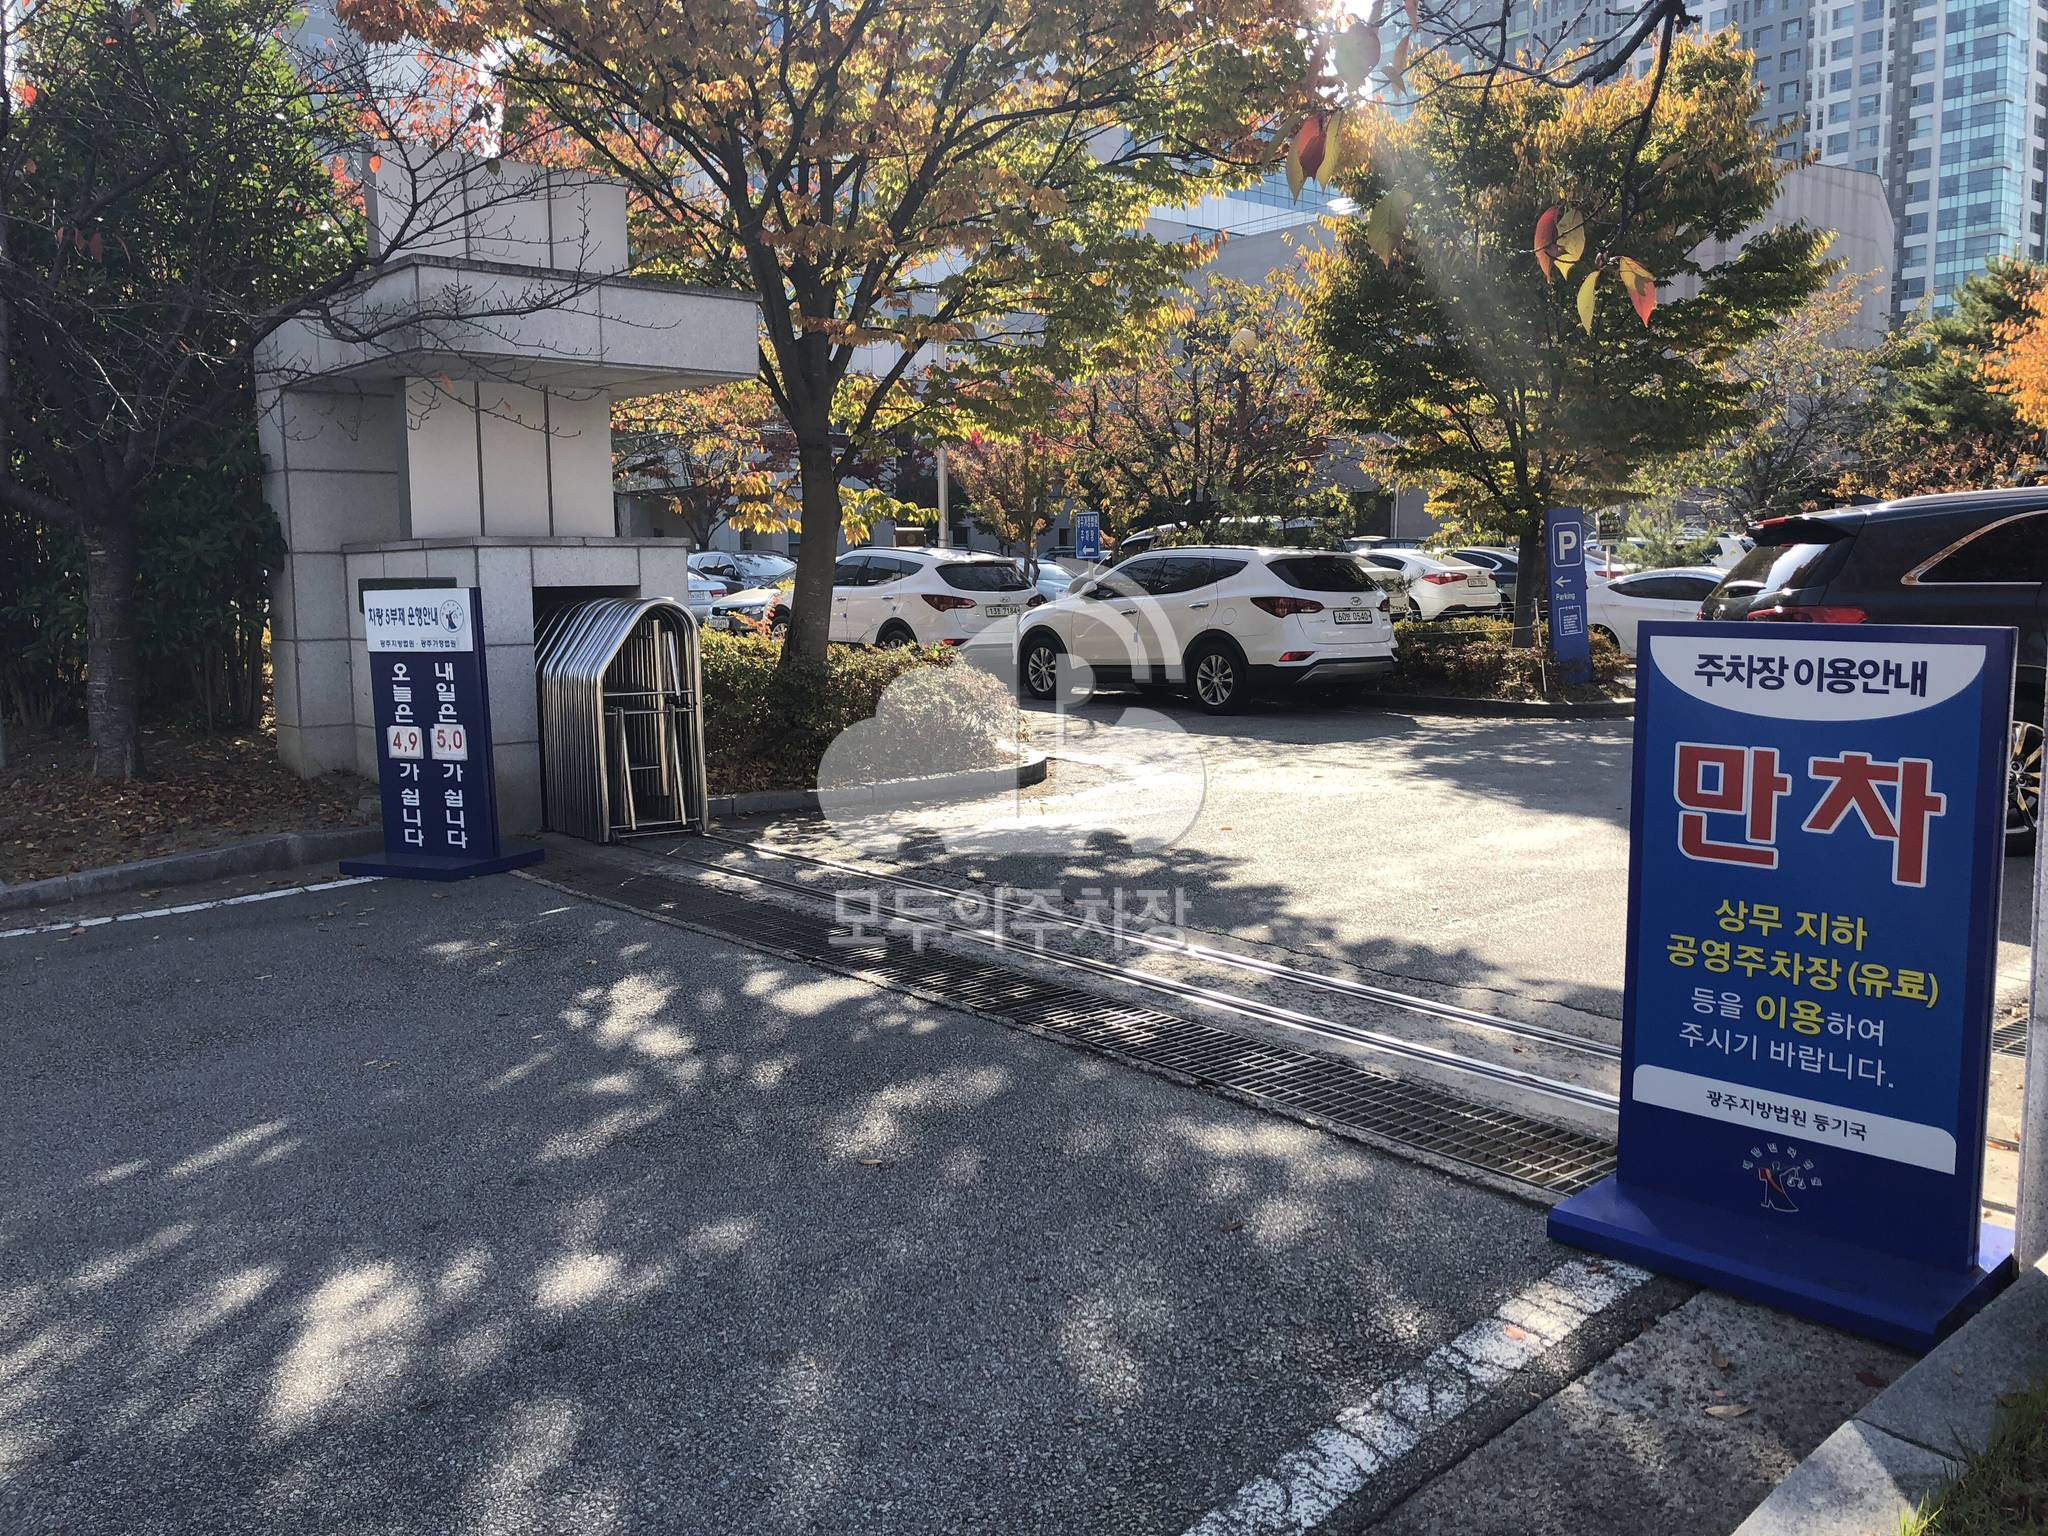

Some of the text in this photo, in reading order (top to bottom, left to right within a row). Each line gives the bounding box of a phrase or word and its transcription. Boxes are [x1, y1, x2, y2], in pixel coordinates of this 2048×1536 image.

[1559, 531, 1577, 560] P
[369, 608, 383, 626] 차량
[386, 608, 405, 626] 5부제
[408, 607, 438, 627] 운행안내
[1555, 592, 1575, 601] Parking
[380, 640, 456, 648] 광주지방법원 광주가정법원
[392, 663, 413, 723] 오늘은
[435, 662, 457, 723] 내일은
[1694, 654, 1927, 696] 주차장 이용안내
[400, 763, 419, 781] 가
[443, 764, 463, 782] 가
[401, 788, 424, 847] 쉽니다
[444, 789, 467, 848] 쉽니다
[1673, 741, 1946, 888] 만차
[1715, 899, 1868, 951] 상무 지하
[1691, 988, 1884, 1047] 등을 이용하여
[1679, 1022, 1894, 1088] 주시기 바랍니다.
[1706, 1091, 1866, 1141] 광주지방법원 등기국
